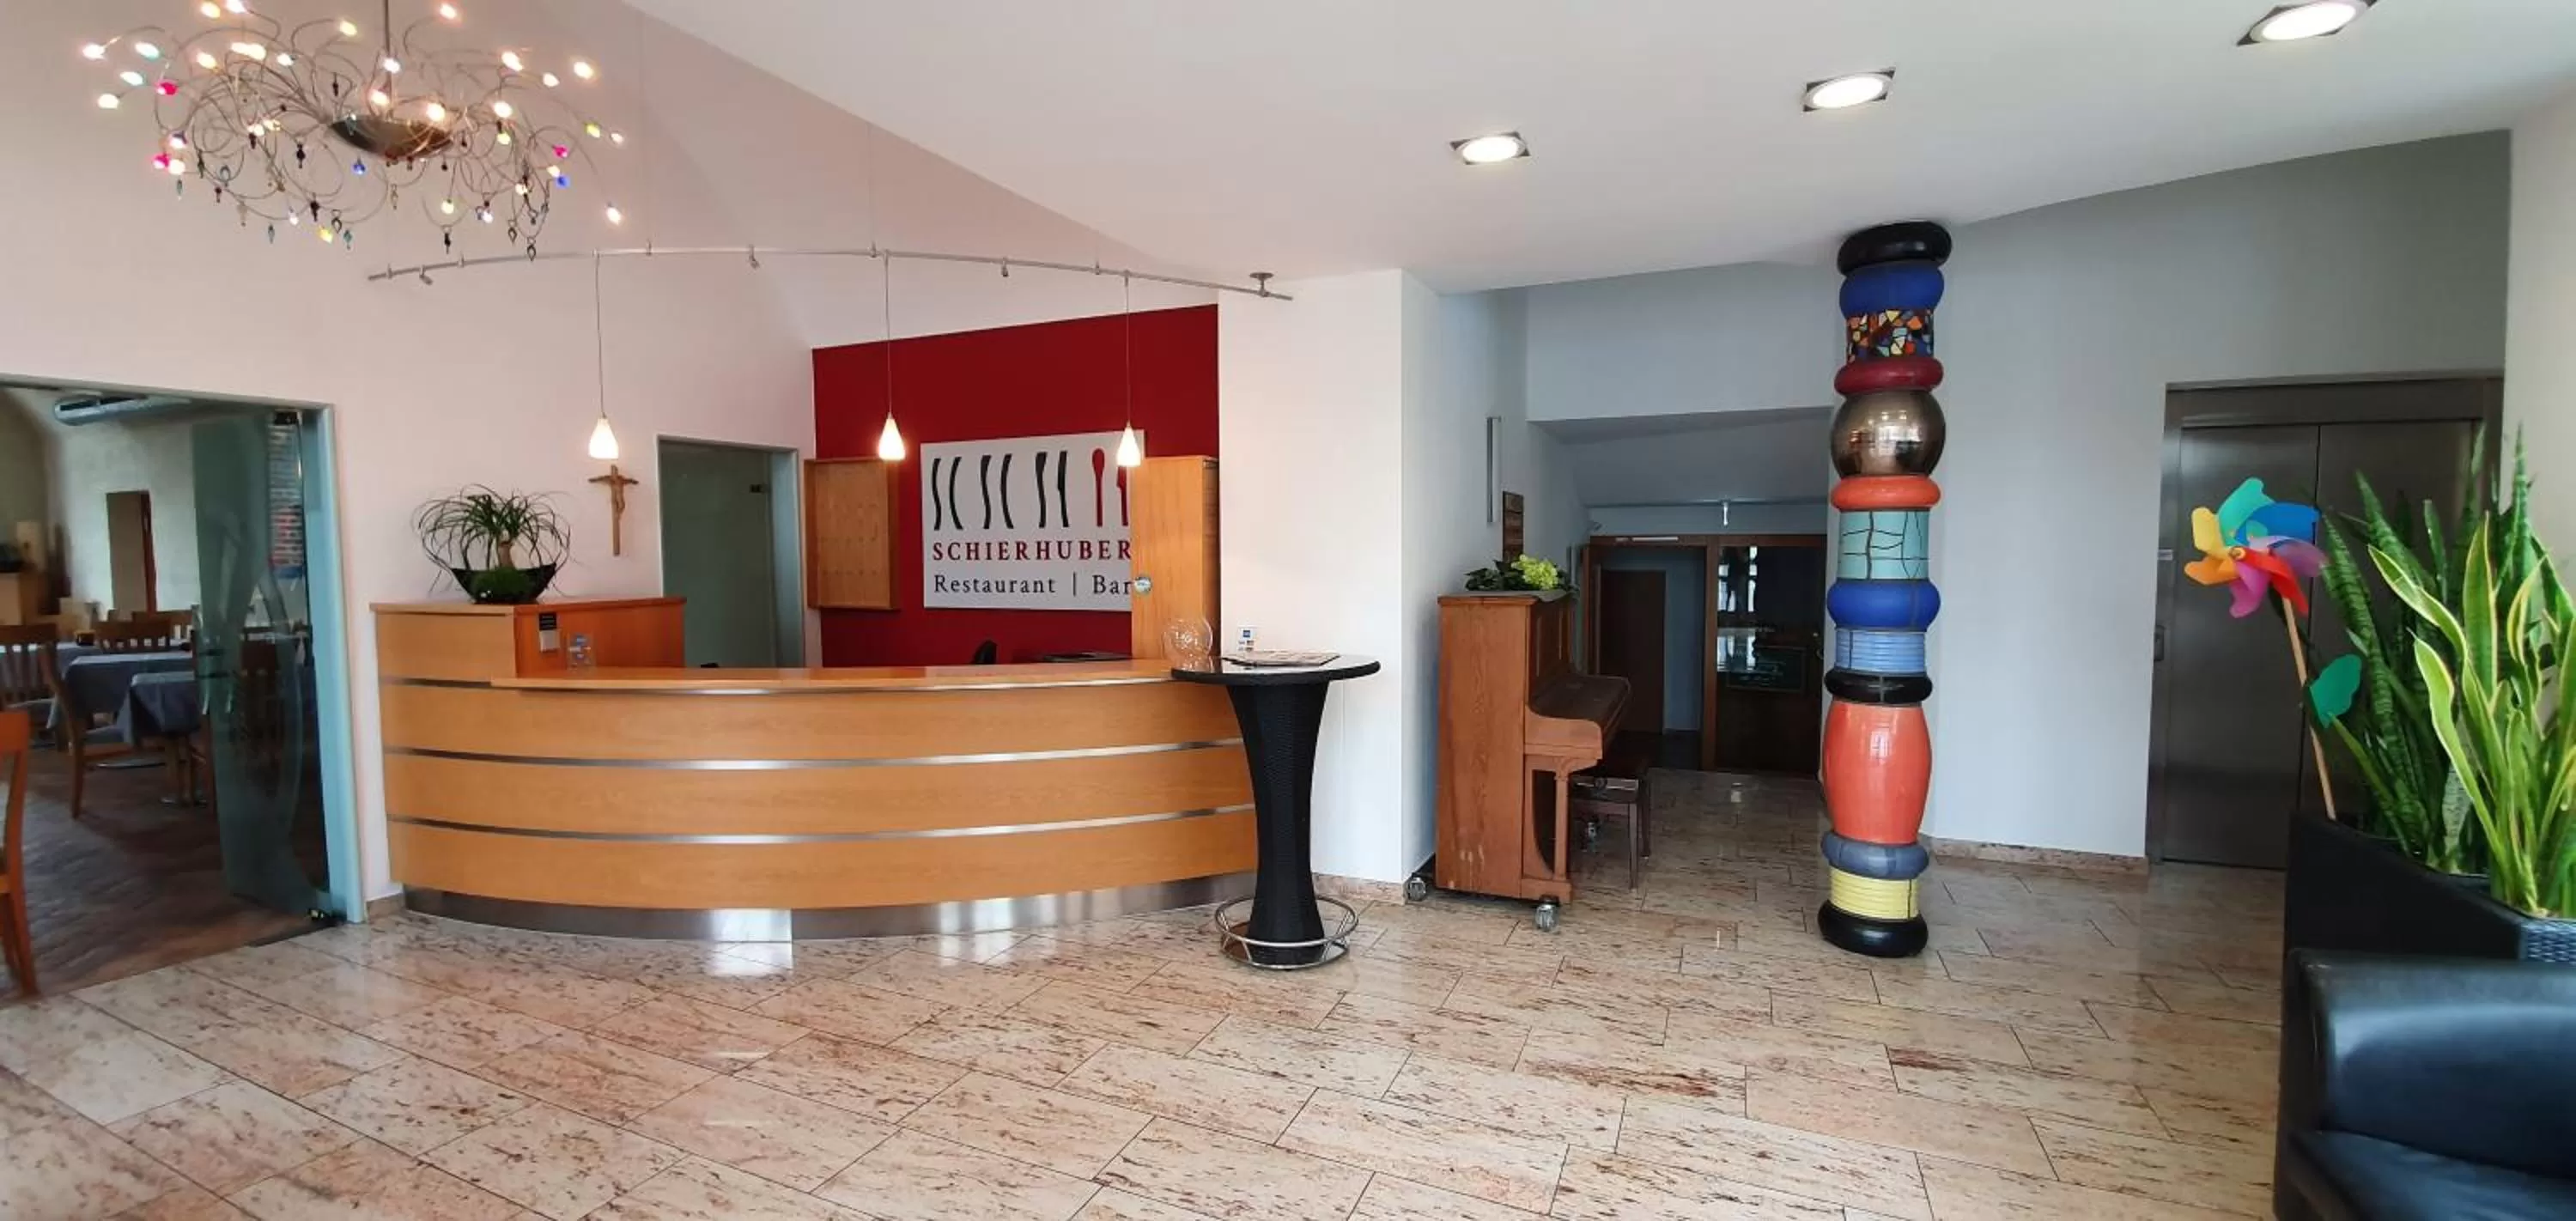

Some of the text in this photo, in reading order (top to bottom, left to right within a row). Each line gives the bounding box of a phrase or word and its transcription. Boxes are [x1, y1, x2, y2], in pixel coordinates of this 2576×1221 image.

[933, 541, 1132, 561] SCHIERHUBER
[933, 574, 1056, 593] Restaurant
[1092, 574, 1132, 595] Bar
